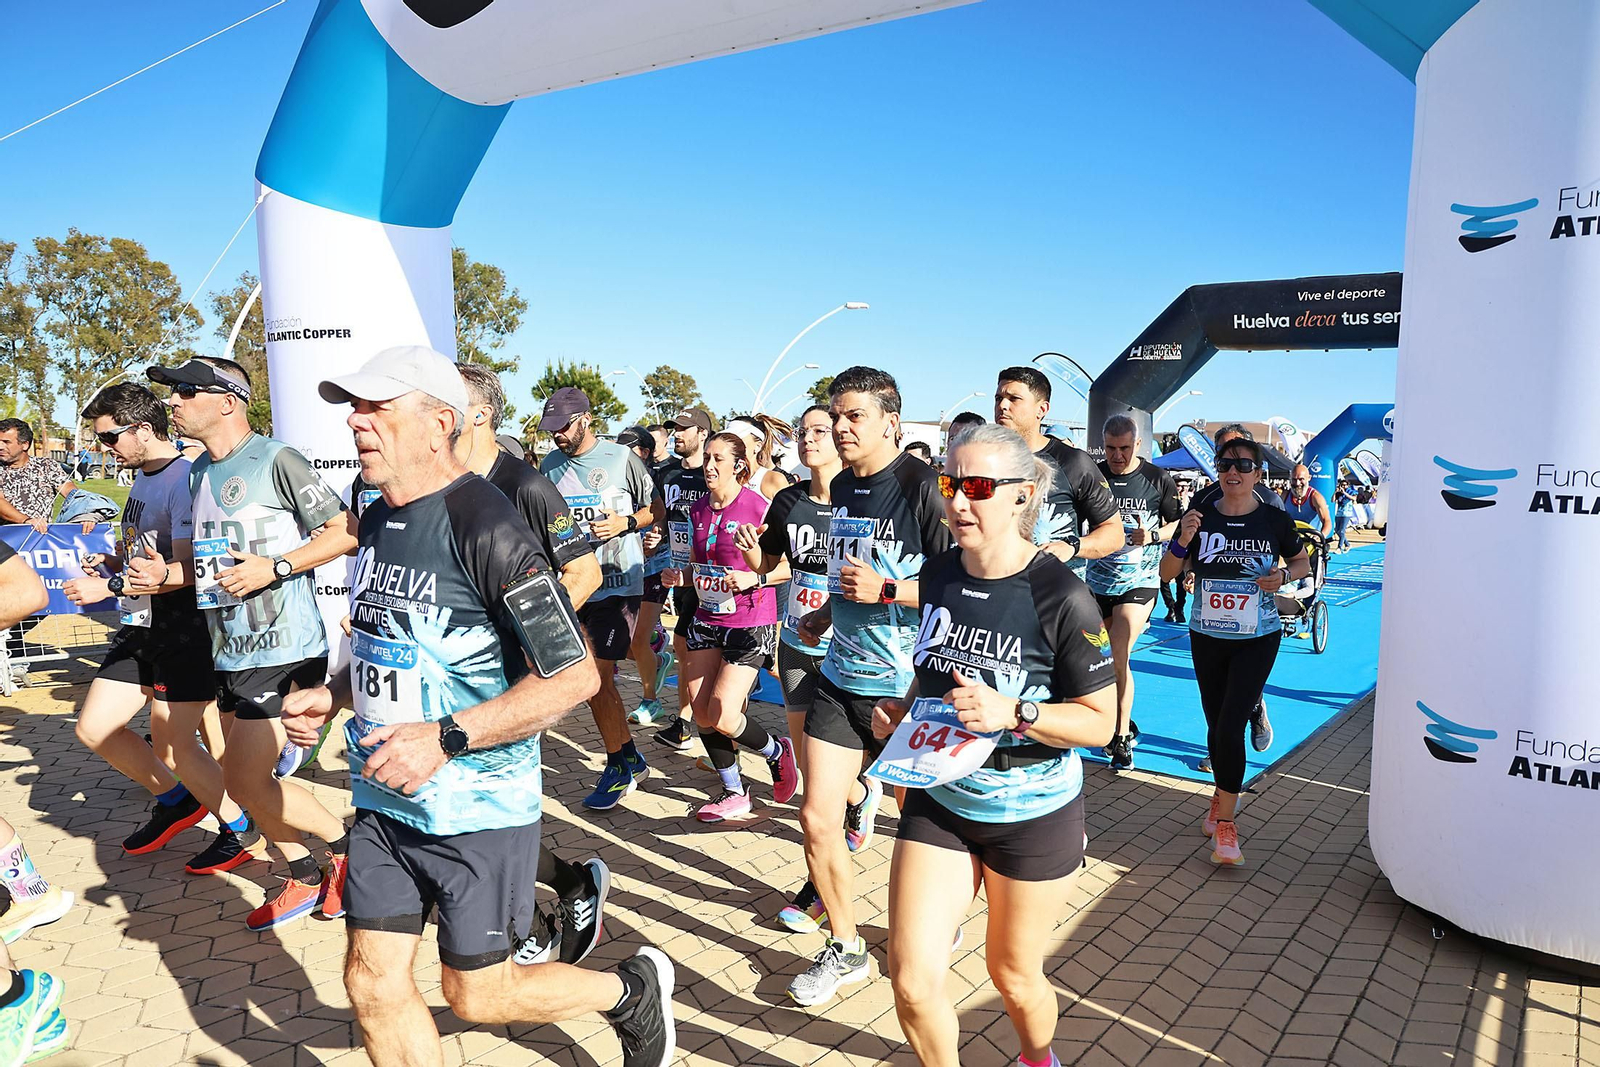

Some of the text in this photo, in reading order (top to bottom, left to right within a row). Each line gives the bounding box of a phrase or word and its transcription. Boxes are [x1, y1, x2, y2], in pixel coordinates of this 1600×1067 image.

[1297, 288, 1386, 301] Vive el deporte
[1233, 313, 1290, 329] Huelva
[1294, 310, 1337, 328] eleva
[1341, 311, 1370, 325] tus
[267, 328, 351, 343] ATLANTIC COPPER
[313, 459, 361, 469] COPPER
[568, 507, 595, 522] 50
[1225, 539, 1272, 553] HUELVA
[366, 561, 437, 604] HUELVA
[796, 588, 830, 608] 48
[1210, 593, 1250, 611] 667
[943, 622, 1023, 664] HUELVA
[393, 646, 414, 665] '24
[939, 646, 959, 658] PUERTA
[959, 650, 969, 661] DEL
[356, 660, 398, 702] 181
[908, 722, 979, 758] 647
